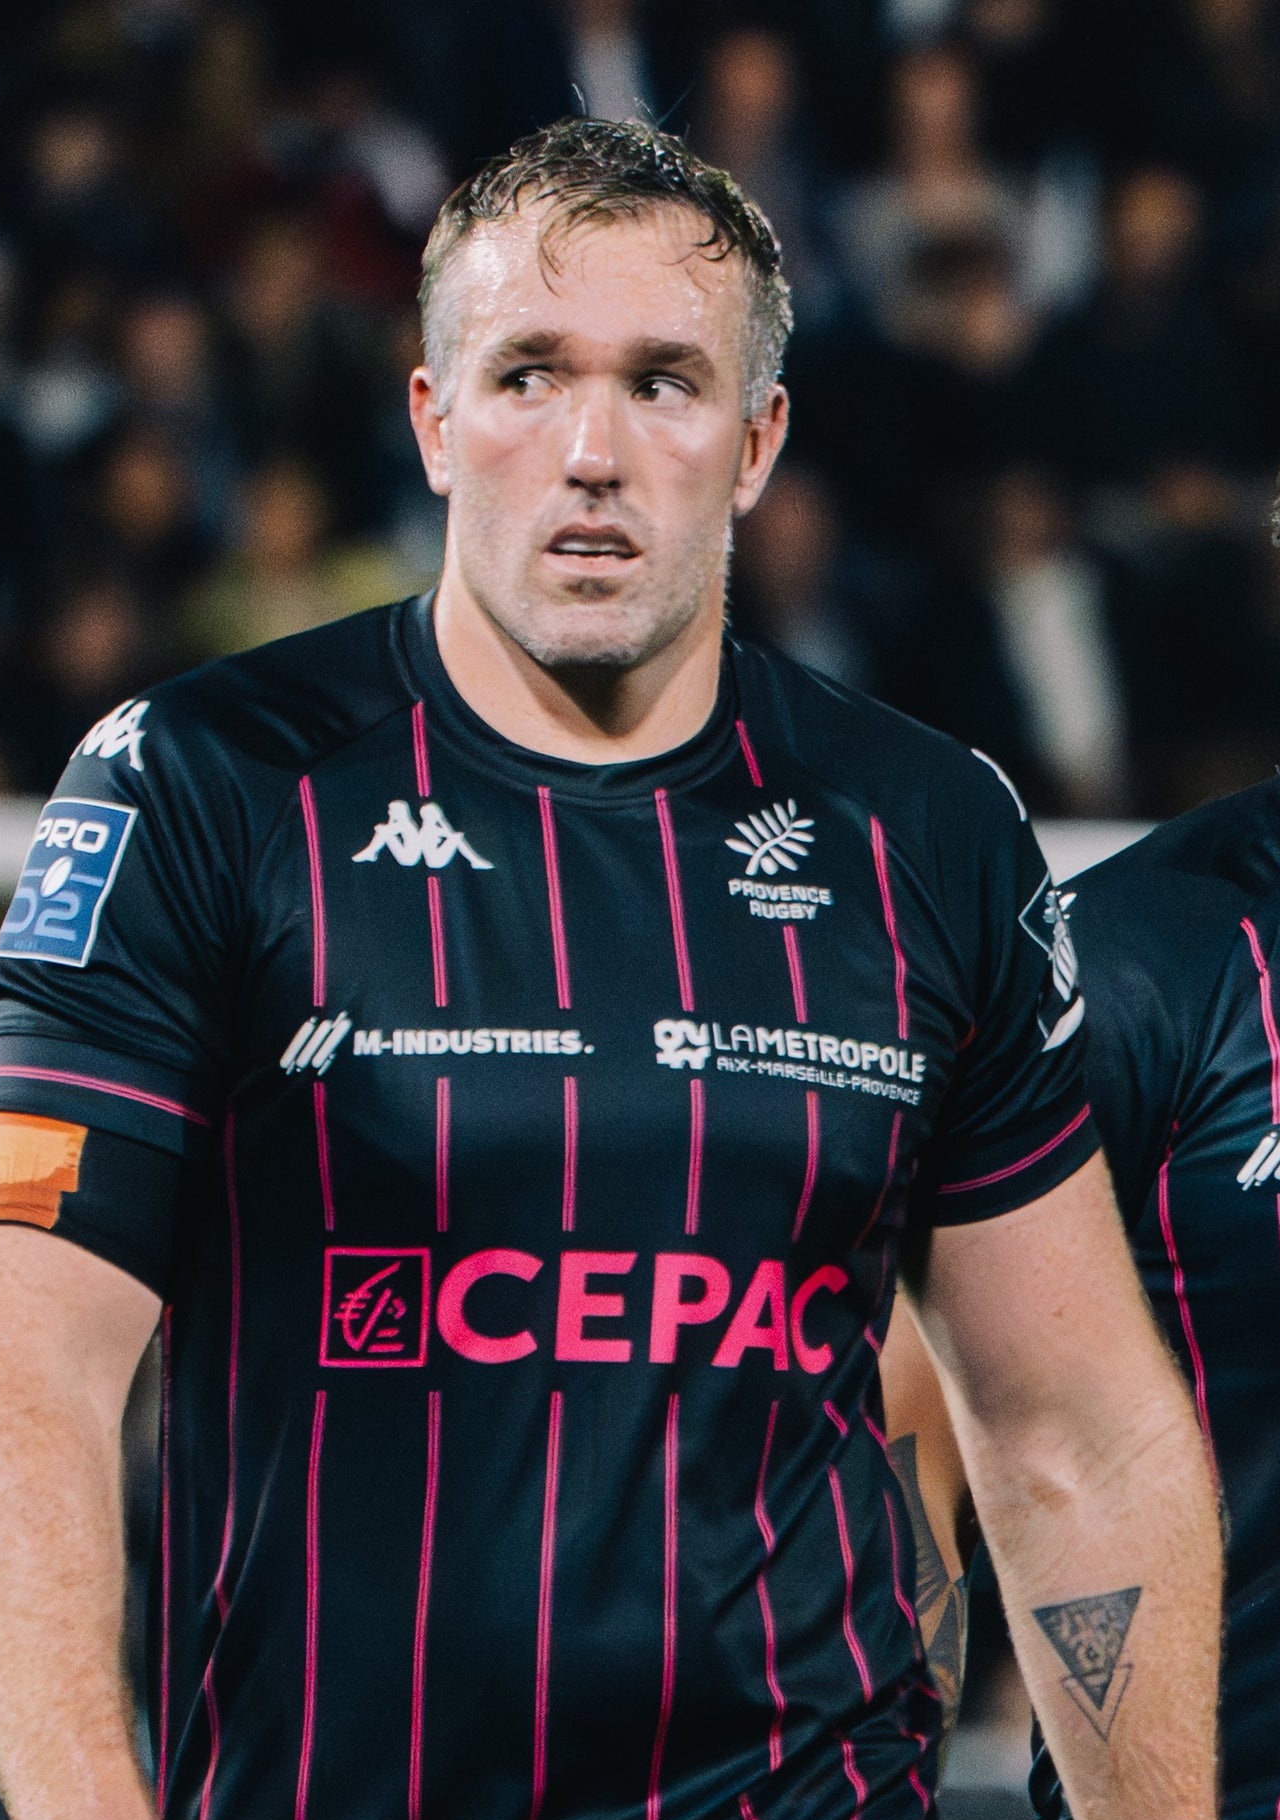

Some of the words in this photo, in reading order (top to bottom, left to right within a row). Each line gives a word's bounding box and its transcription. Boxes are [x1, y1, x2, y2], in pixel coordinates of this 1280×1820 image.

[34, 818, 109, 854] PRO
[727, 877, 834, 906] PROVENCE
[749, 899, 818, 920] RUGBY
[352, 1027, 596, 1057] M-INDUSTRIES.
[436, 1247, 850, 1375] CEPAC
